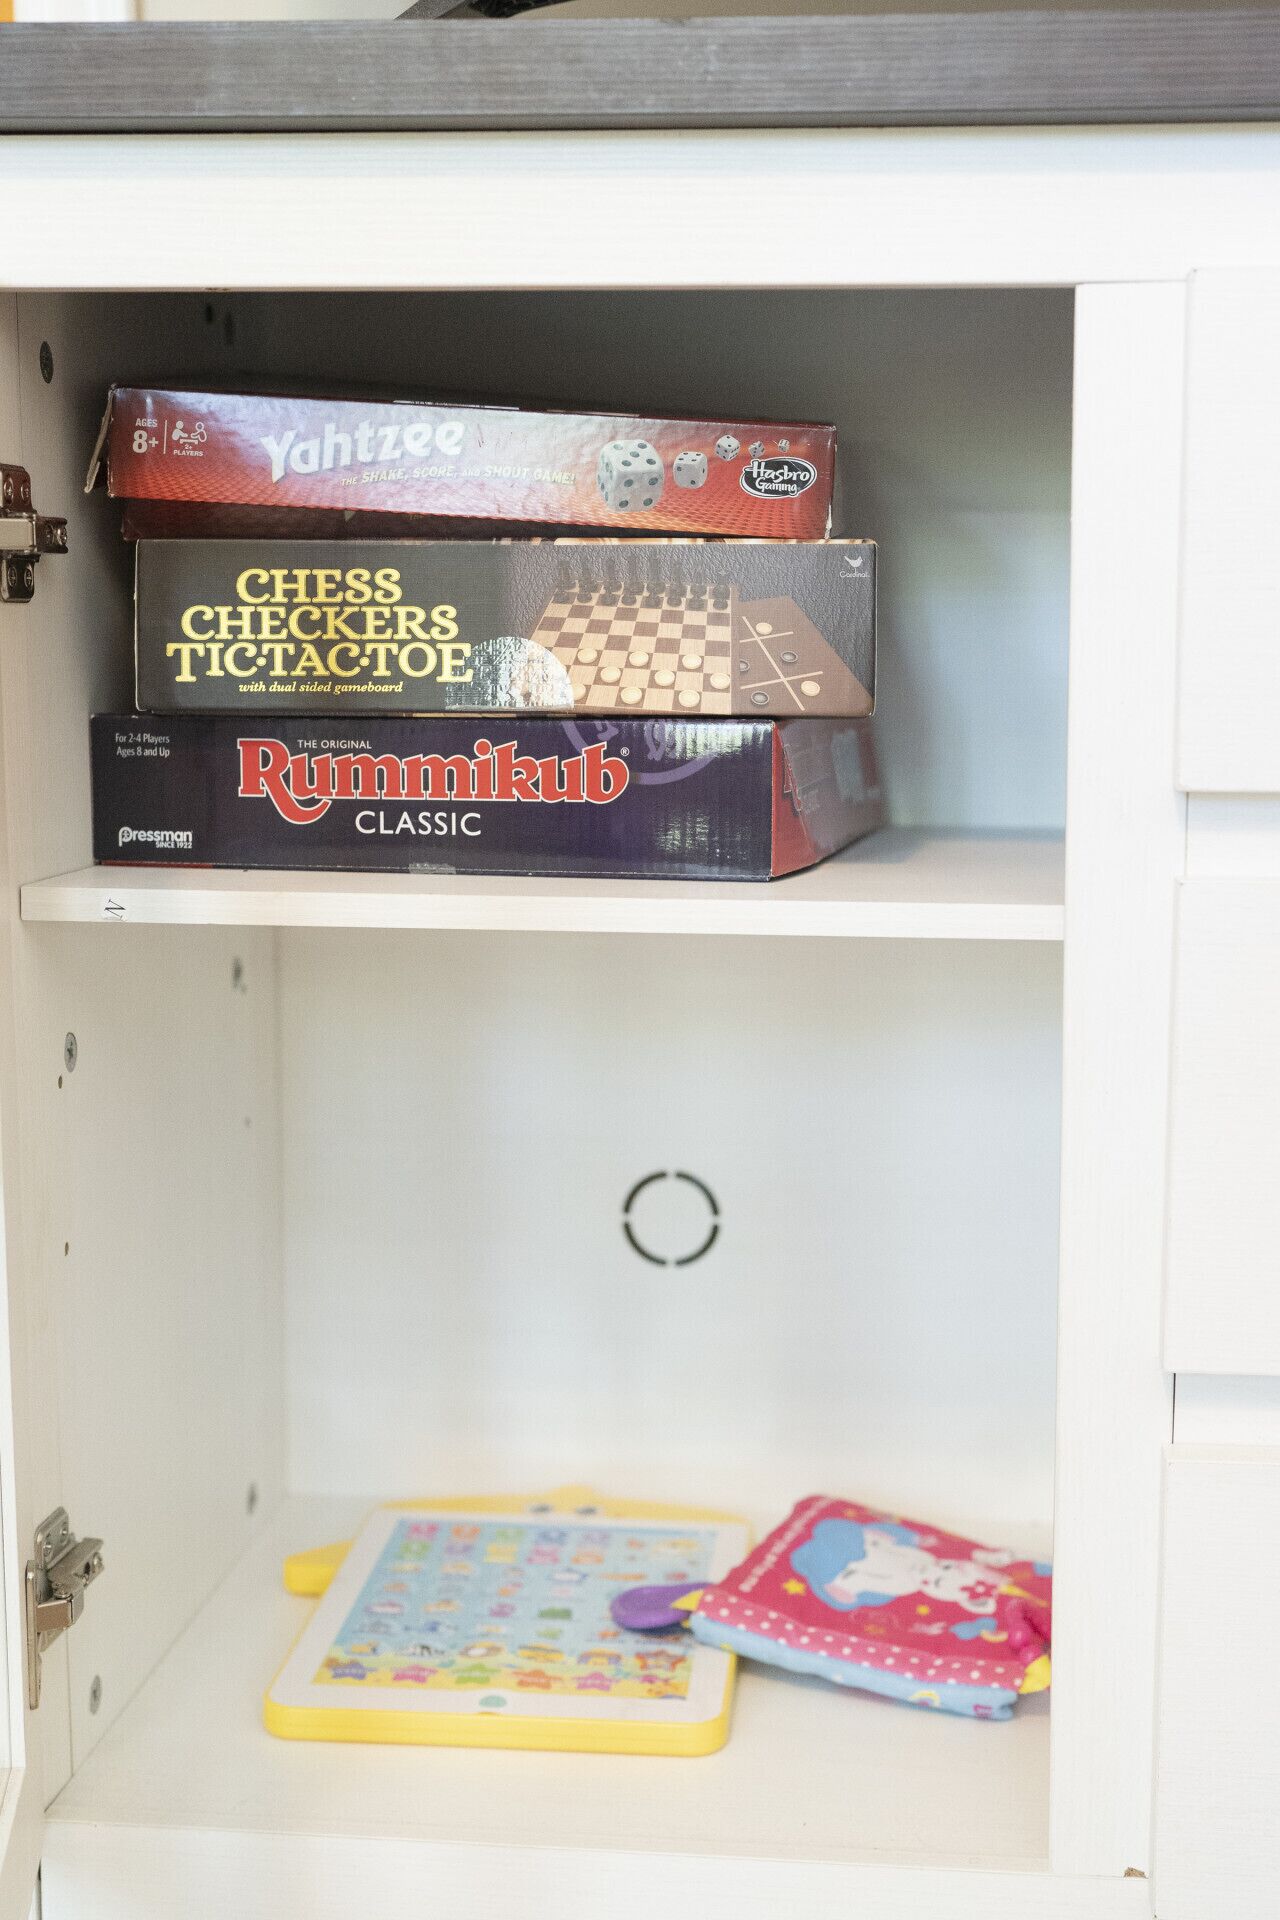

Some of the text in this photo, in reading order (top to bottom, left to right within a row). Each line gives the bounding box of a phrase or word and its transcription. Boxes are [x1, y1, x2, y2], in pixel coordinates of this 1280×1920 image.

[135, 418, 158, 428] AGES
[132, 429, 159, 453] 8+
[173, 449, 204, 457] PLAYERS
[260, 420, 466, 484] Yahtzee
[341, 476, 358, 486] THE
[361, 468, 409, 483] SHAKE,
[412, 464, 457, 479] SCORE,
[485, 465, 530, 479] SHOUT
[533, 468, 577, 485] GAME!
[744, 460, 810, 483] Hasbro
[755, 477, 798, 495] Gaming
[235, 568, 403, 604] CHESS
[180, 604, 460, 641] CHECKERS
[238, 681, 404, 696] with dual sided gameboard
[115, 732, 170, 745] For 2-4 Players
[297, 739, 372, 750] THE ORIGINAL
[116, 746, 170, 759] Ages 8 and Up
[355, 810, 482, 836] CLASSIC
[155, 841, 193, 849] SINCE 1922
